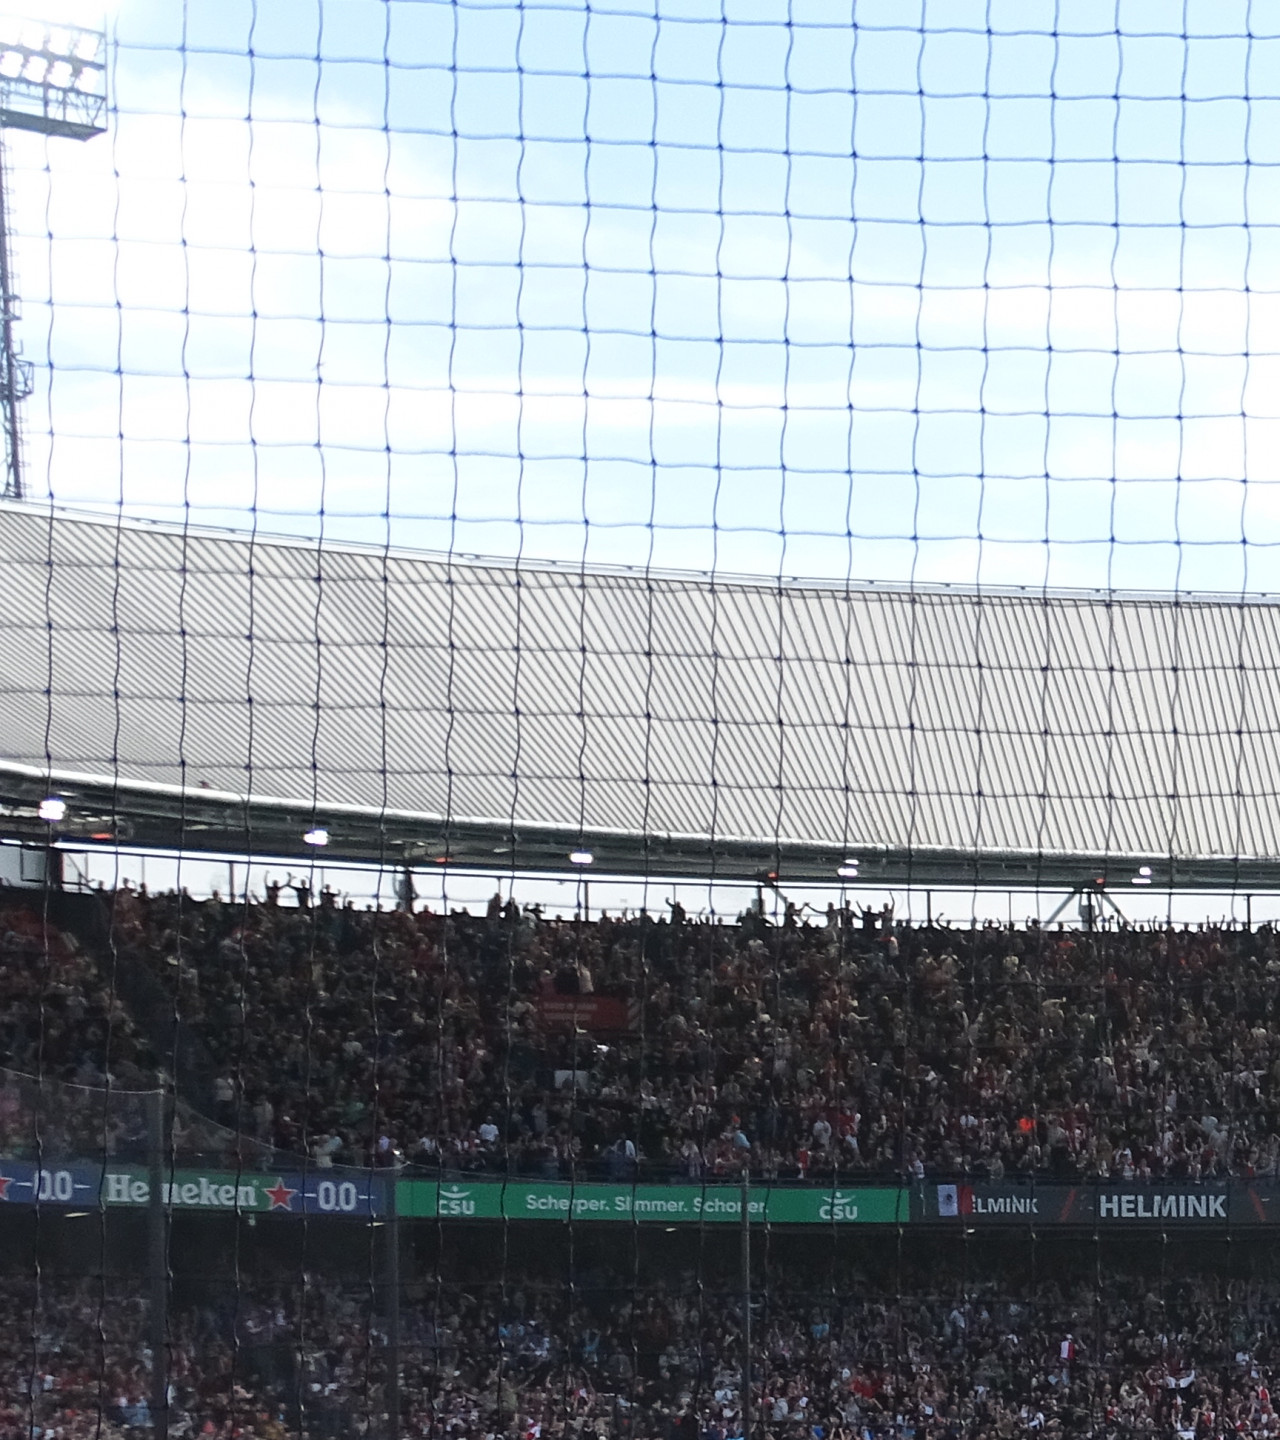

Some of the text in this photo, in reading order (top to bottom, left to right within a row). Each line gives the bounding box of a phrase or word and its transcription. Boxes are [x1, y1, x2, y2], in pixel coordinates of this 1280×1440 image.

[105, 1174, 258, 1207] Heneken
[318, 1181, 357, 1211] 0.0
[438, 1199, 476, 1216] CSU
[614, 1196, 688, 1212] Slmmer.
[1100, 1194, 1228, 1218] HELMINK
[820, 1206, 858, 1220] CSU
